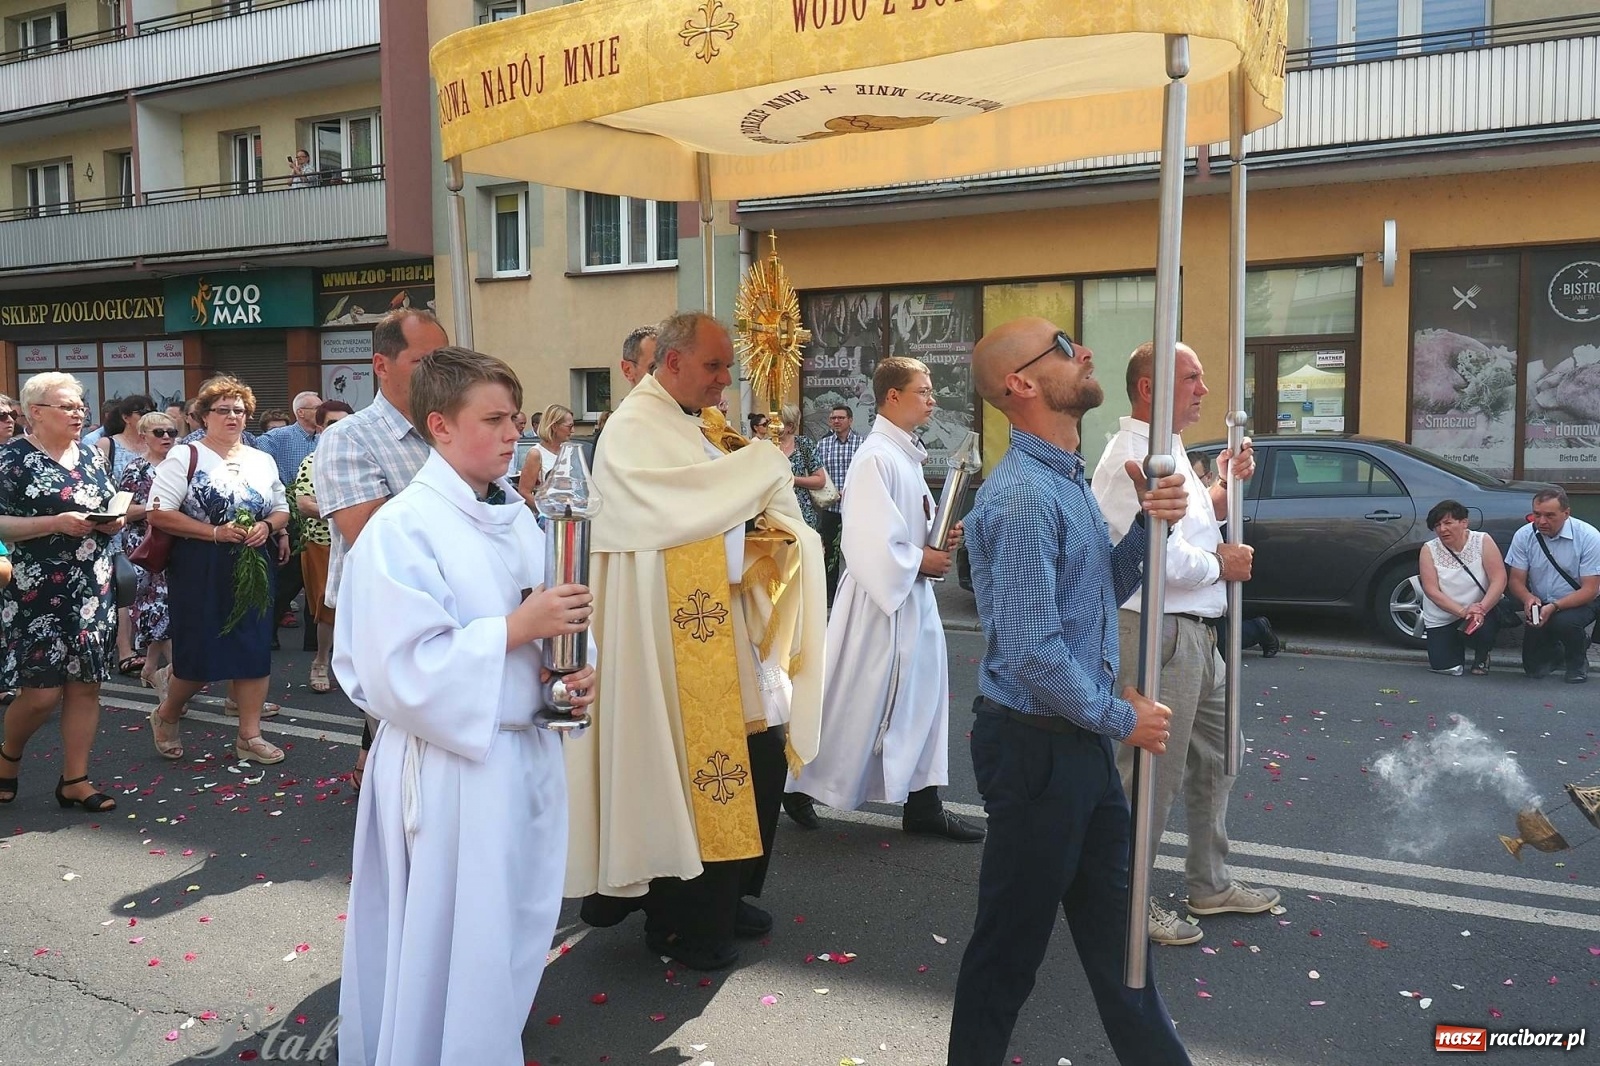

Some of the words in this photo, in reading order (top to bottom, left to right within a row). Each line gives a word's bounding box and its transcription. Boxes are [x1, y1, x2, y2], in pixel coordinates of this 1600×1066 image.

[481, 53, 545, 108] NAPÓJ
[563, 35, 620, 87] MNIE
[856, 84, 908, 98] MNIE
[762, 89, 810, 110] MNIE
[212, 284, 260, 305] ZOO
[1, 304, 49, 326] SKLEP
[52, 296, 165, 323] ZOOLOGICZNY
[212, 304, 262, 325] MAR
[909, 342, 952, 350] Zapraszamy
[814, 354, 859, 371] Sklep
[806, 375, 860, 388] Firmowy
[1425, 414, 1476, 429] Smaczne
[1463, 454, 1479, 462] Caffe
[1559, 454, 1579, 462] Bistro
[1580, 454, 1597, 462] Caffe
